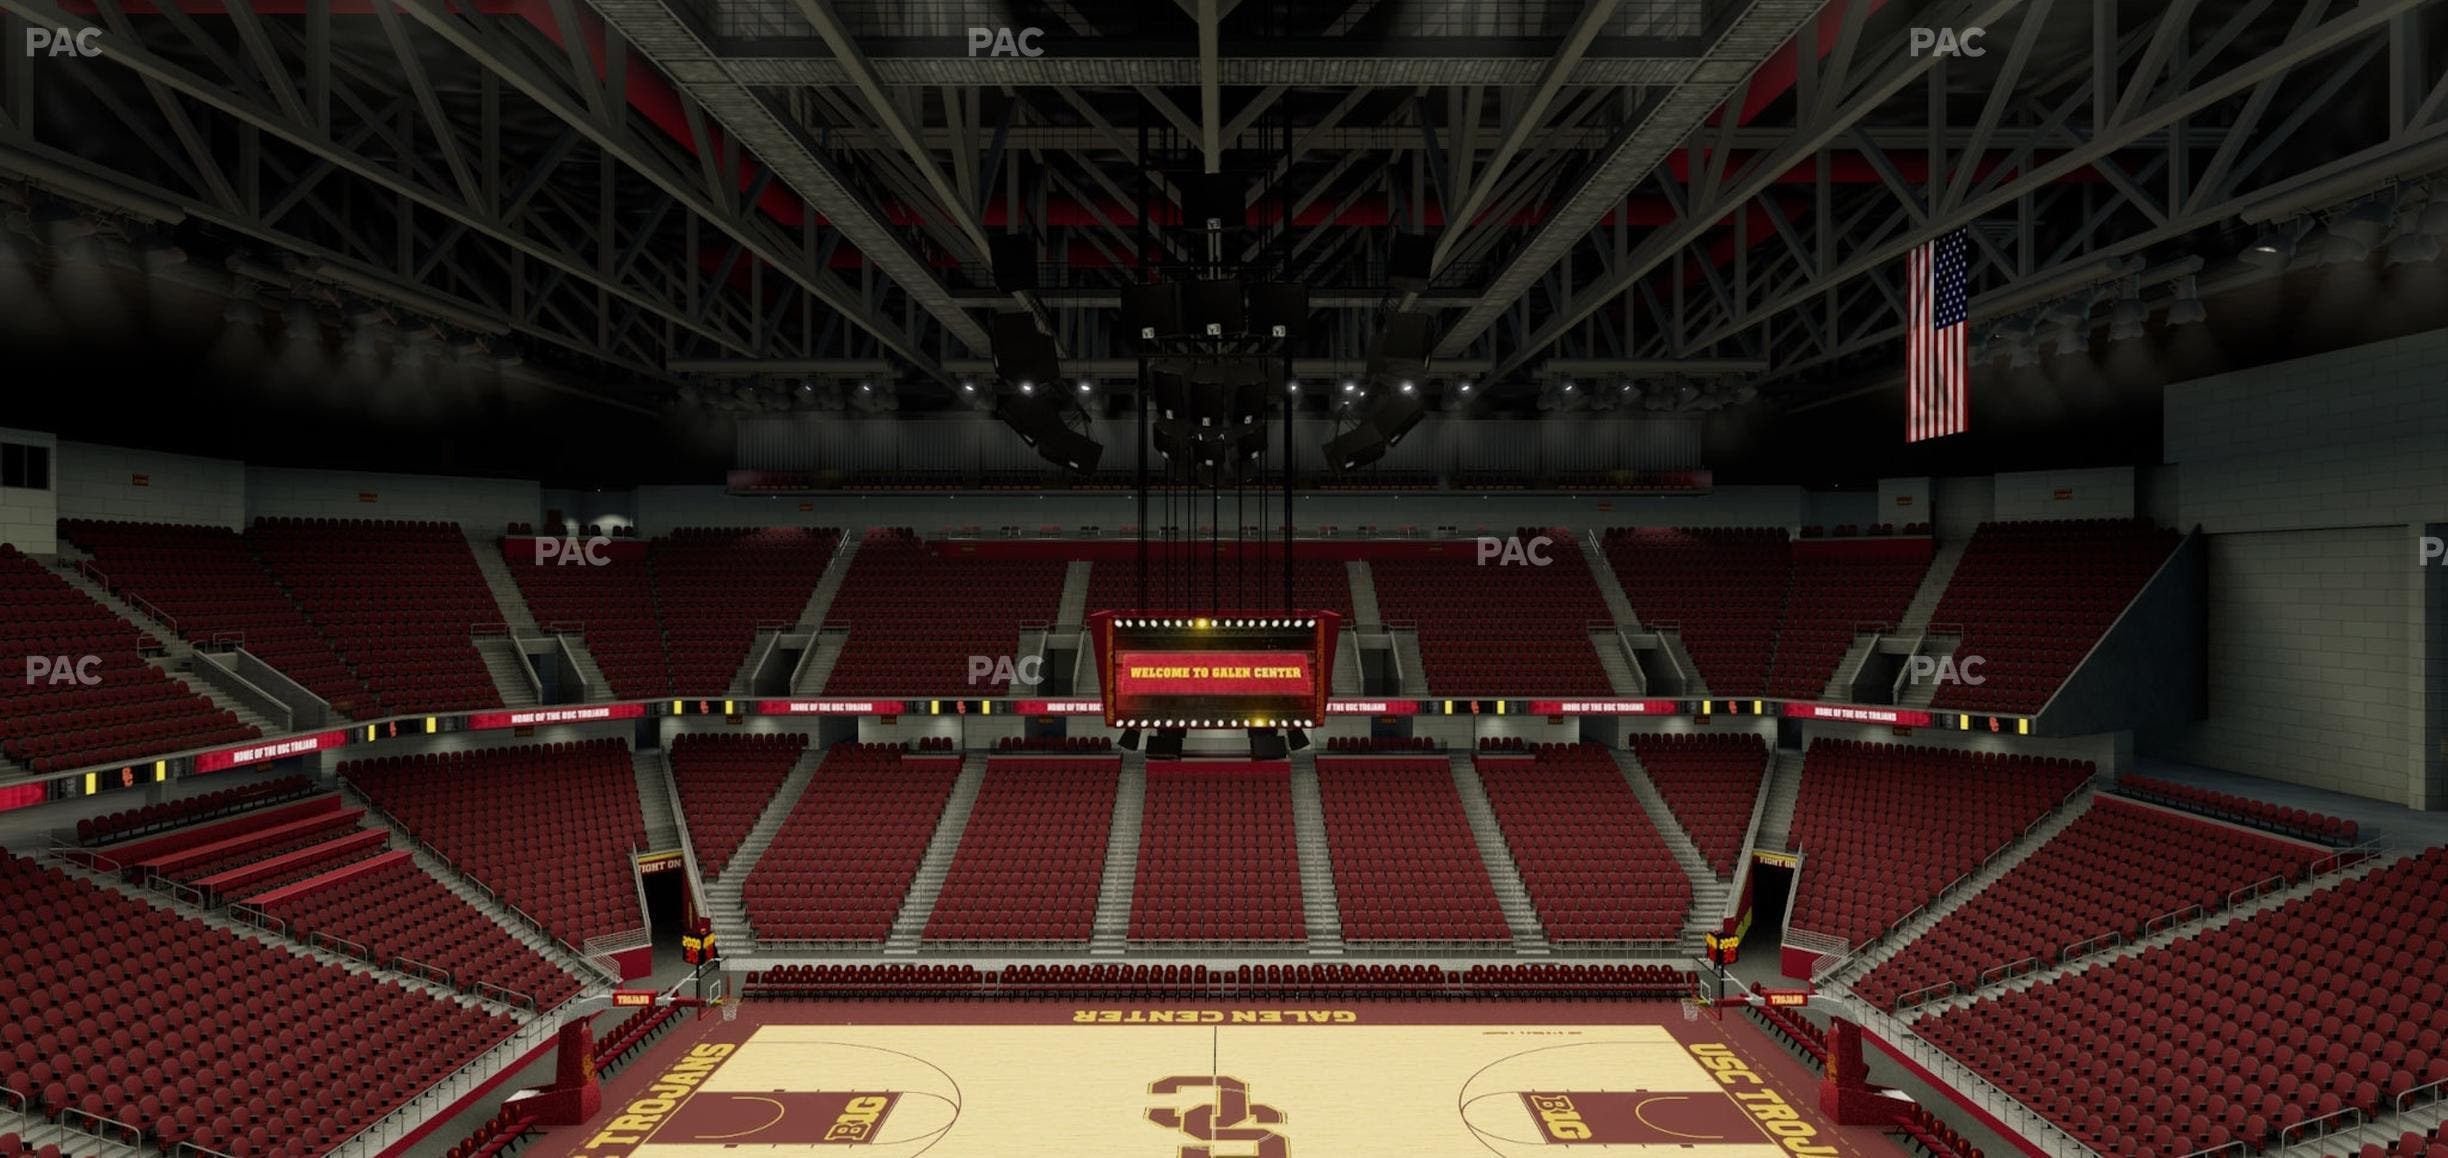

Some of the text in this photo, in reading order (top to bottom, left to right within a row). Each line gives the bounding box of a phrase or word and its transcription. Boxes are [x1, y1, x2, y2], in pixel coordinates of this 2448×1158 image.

[1131, 667, 1301, 678] WELCOME TO GALEN CENTER
[809, 703, 818, 711] OF
[819, 703, 830, 711] THE
[1076, 703, 1087, 711] THE
[1582, 703, 1590, 711] OF
[1591, 703, 1602, 711] THE
[535, 713, 545, 721] OF
[546, 712, 560, 720] THE
[1833, 708, 1841, 717] OF
[1842, 709, 1854, 718] THE
[255, 748, 264, 759] OF
[265, 746, 276, 757] THE
[640, 859, 682, 873] IGHT ON
[616, 995, 649, 1004] TROJANS
[1771, 995, 1803, 1005] TROJANS
[1072, 1010, 1357, 1023] GALEN CENTER
[1689, 1043, 1764, 1084] USC
[584, 1043, 736, 1149] TROJANS
